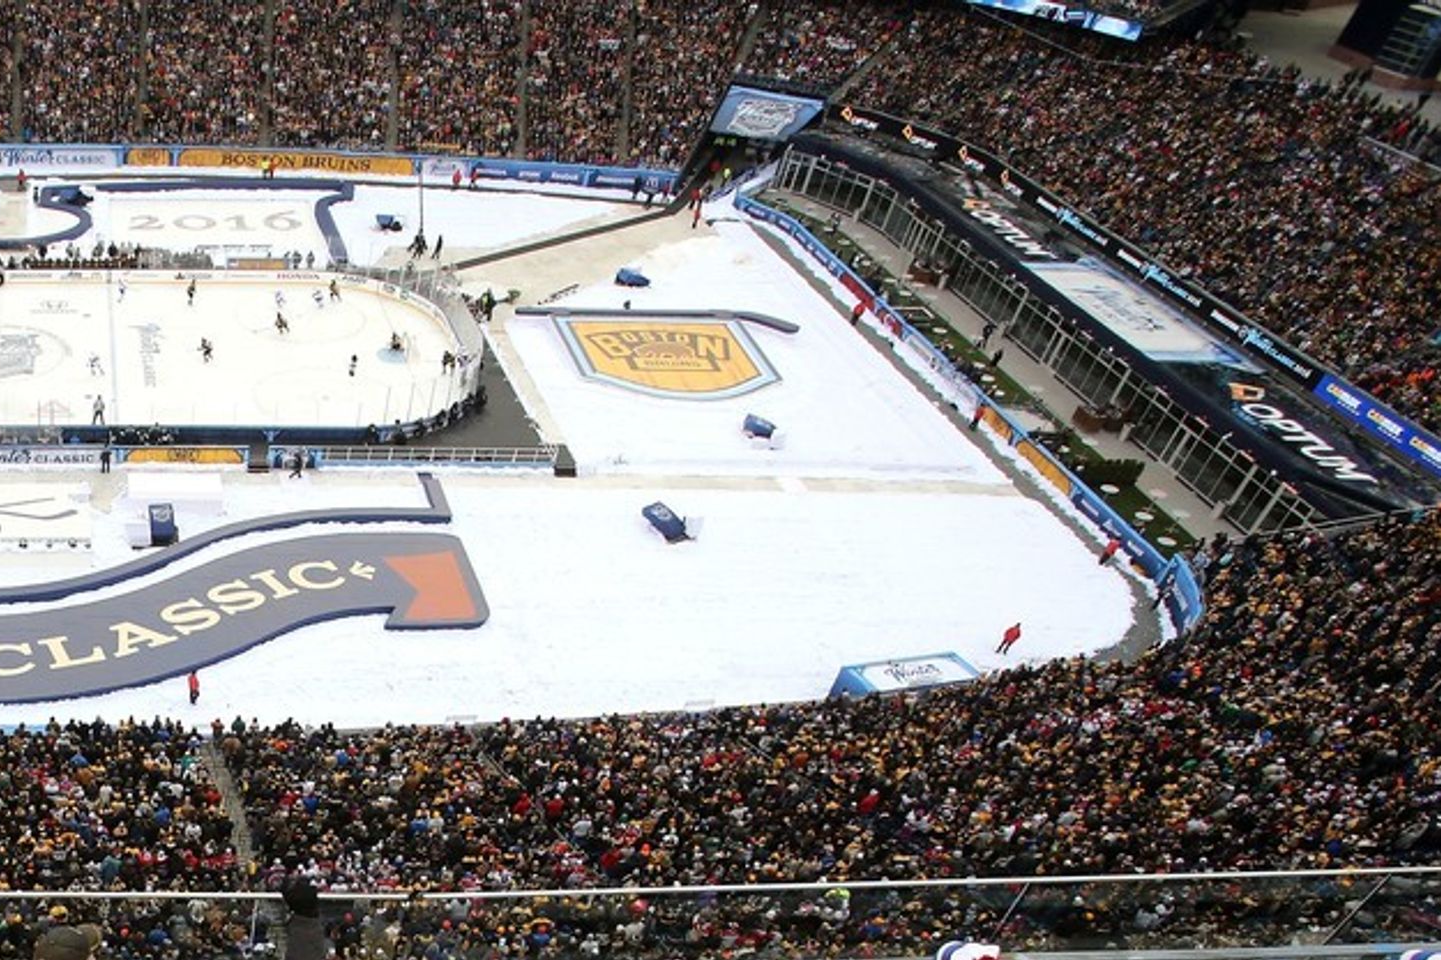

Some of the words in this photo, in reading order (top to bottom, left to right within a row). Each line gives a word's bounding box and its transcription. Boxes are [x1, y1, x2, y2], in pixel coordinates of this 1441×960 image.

[2, 149, 55, 167] Winter
[55, 153, 107, 165] CLASSIC
[301, 154, 372, 171] BRUINS
[127, 210, 303, 232] 2016
[970, 209, 1059, 260] OPTUM
[276, 272, 320, 281] HONDA
[587, 330, 731, 361] BOSTON
[1240, 403, 1379, 485] OPTUM
[34, 454, 95, 464] CLASSIC
